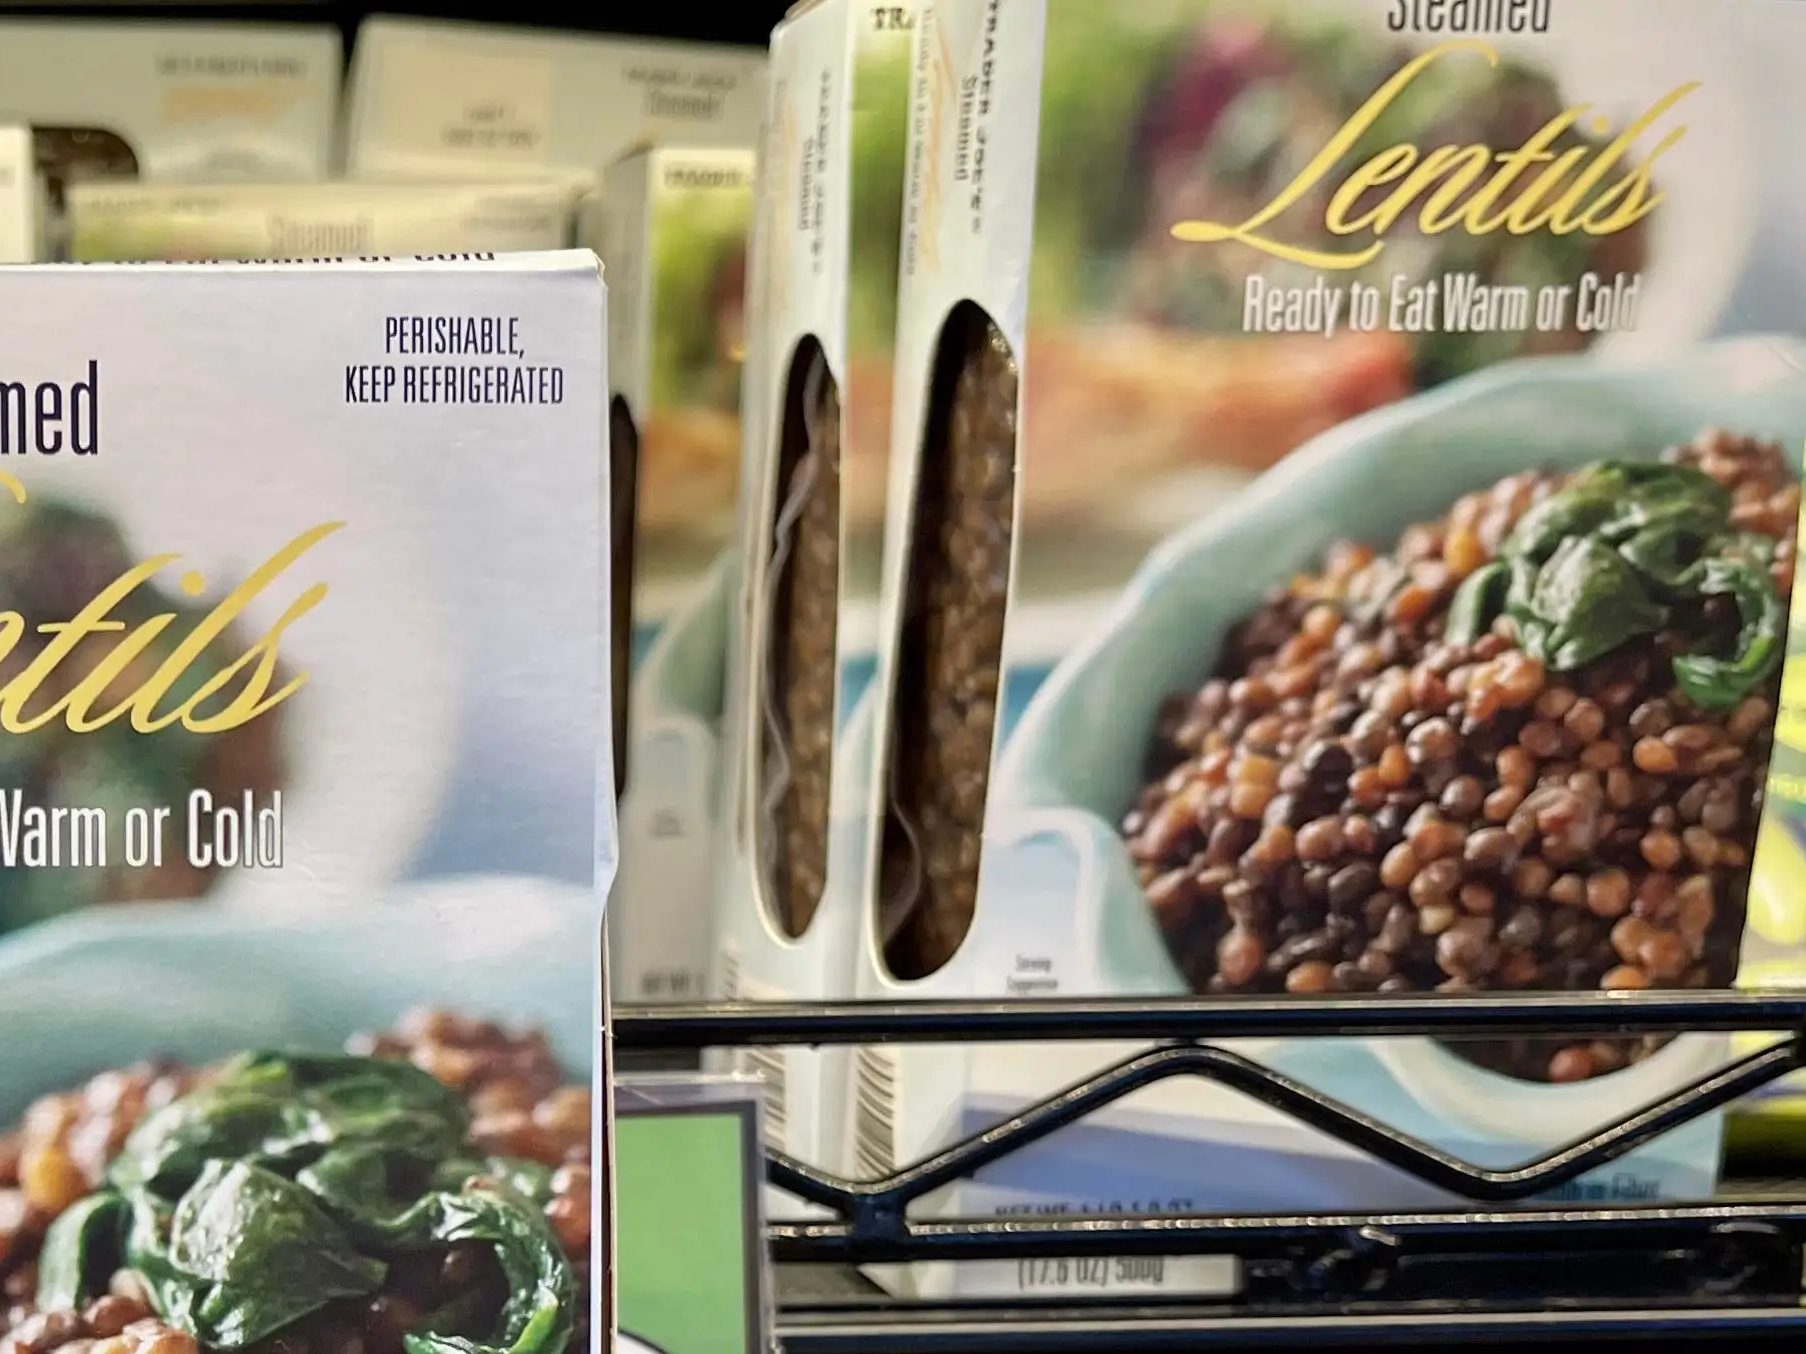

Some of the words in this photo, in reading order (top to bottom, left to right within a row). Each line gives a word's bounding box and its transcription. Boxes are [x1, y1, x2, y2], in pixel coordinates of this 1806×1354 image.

[1170, 39, 1702, 269] Lentils
[385, 316, 524, 359] PERISHABLE,
[1243, 274, 1341, 338] Ready
[1350, 280, 1379, 332] to
[1388, 274, 1436, 332] Eat
[1442, 272, 1530, 333] Warm
[1535, 285, 1571, 332] or
[1575, 272, 1642, 332] Cold
[346, 365, 395, 403] KEEP
[404, 365, 564, 405] REFRIGERATED
[124, 806, 171, 867] or
[187, 788, 285, 868] Cold
